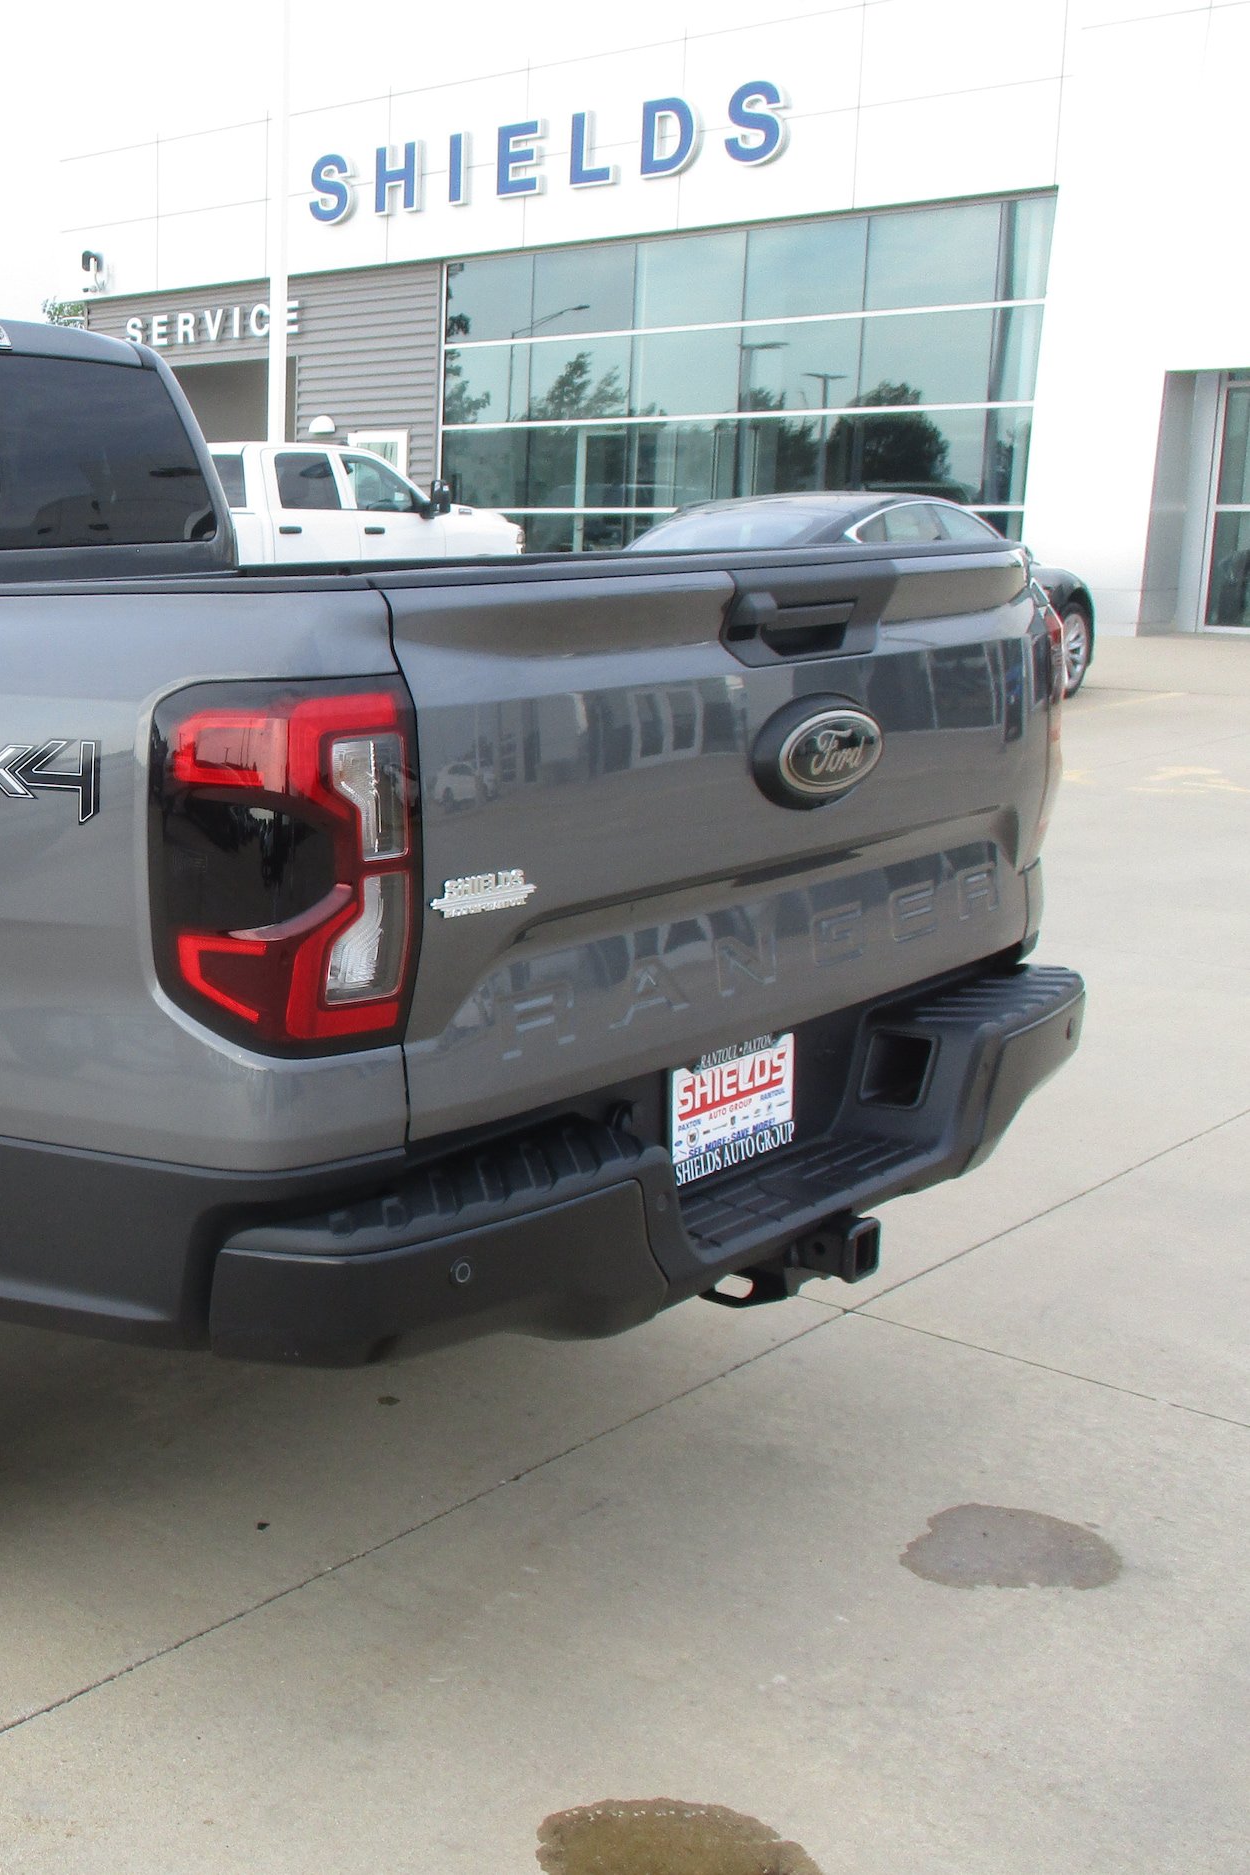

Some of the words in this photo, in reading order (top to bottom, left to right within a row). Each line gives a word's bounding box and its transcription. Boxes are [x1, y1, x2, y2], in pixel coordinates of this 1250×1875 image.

[308, 80, 792, 225] SHIELDS
[125, 300, 299, 347] SERVICE
[810, 728, 866, 776] Ford
[502, 859, 1002, 1061] RANGER
[700, 1044, 739, 1069] RANTOUL
[743, 1034, 772, 1055] PAXTON
[678, 1045, 787, 1116] SHIELDS
[708, 1107, 727, 1120] AUTO
[729, 1098, 752, 1113] GROUP
[675, 1148, 722, 1187] SHIELDS
[723, 1136, 755, 1167] AUTO
[756, 1121, 794, 1153] GROUP
